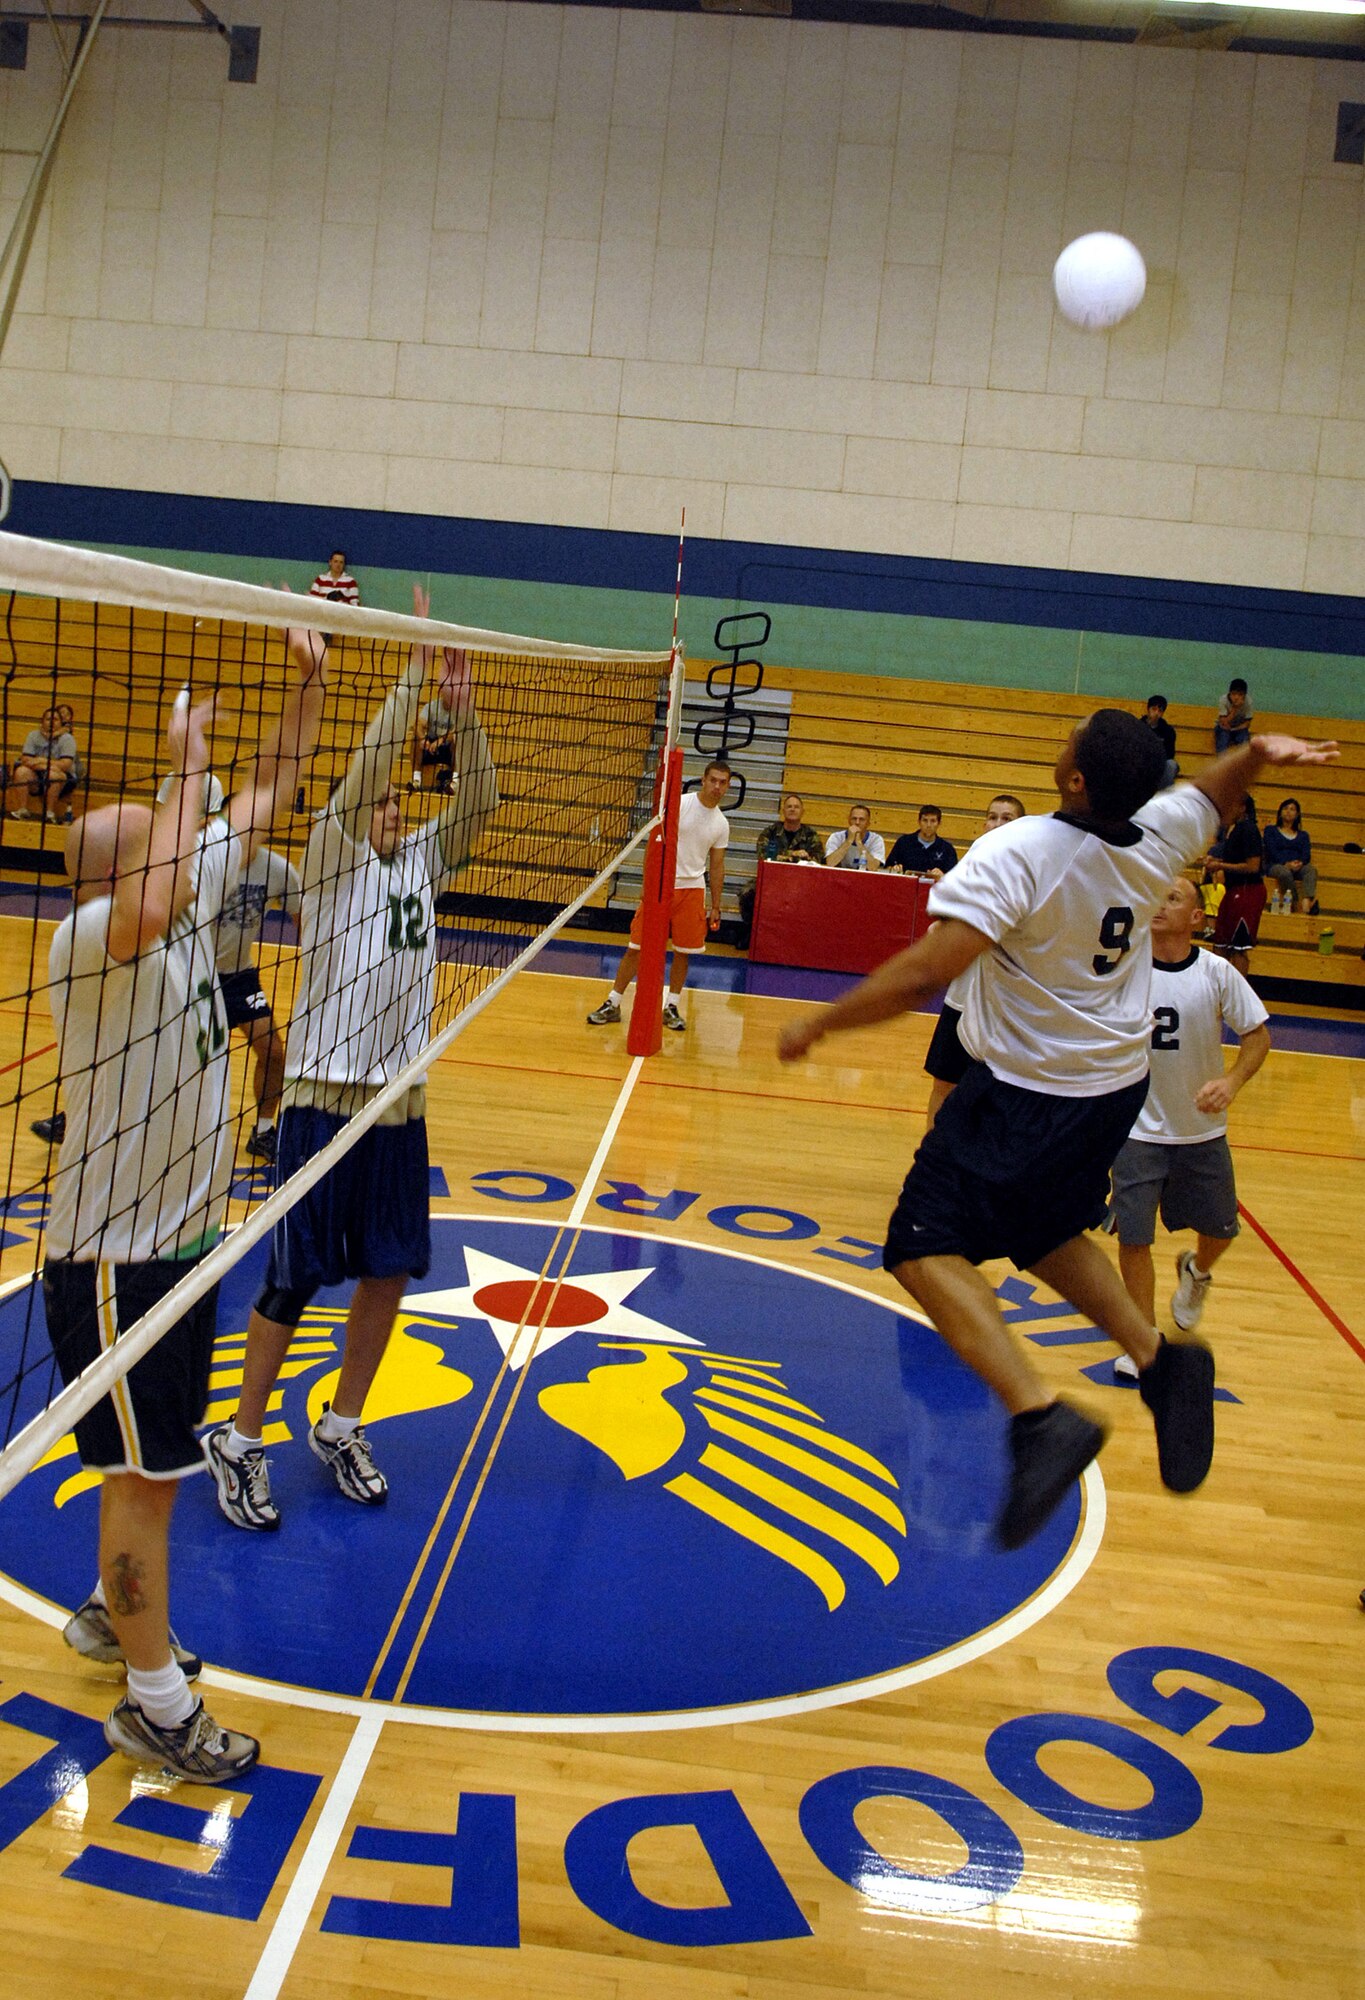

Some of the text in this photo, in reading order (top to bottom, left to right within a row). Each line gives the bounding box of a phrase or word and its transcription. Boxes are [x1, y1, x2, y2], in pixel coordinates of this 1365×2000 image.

[389, 894, 427, 949] 12
[1092, 907, 1134, 976] 9
[429, 1165, 884, 1270] FORC
